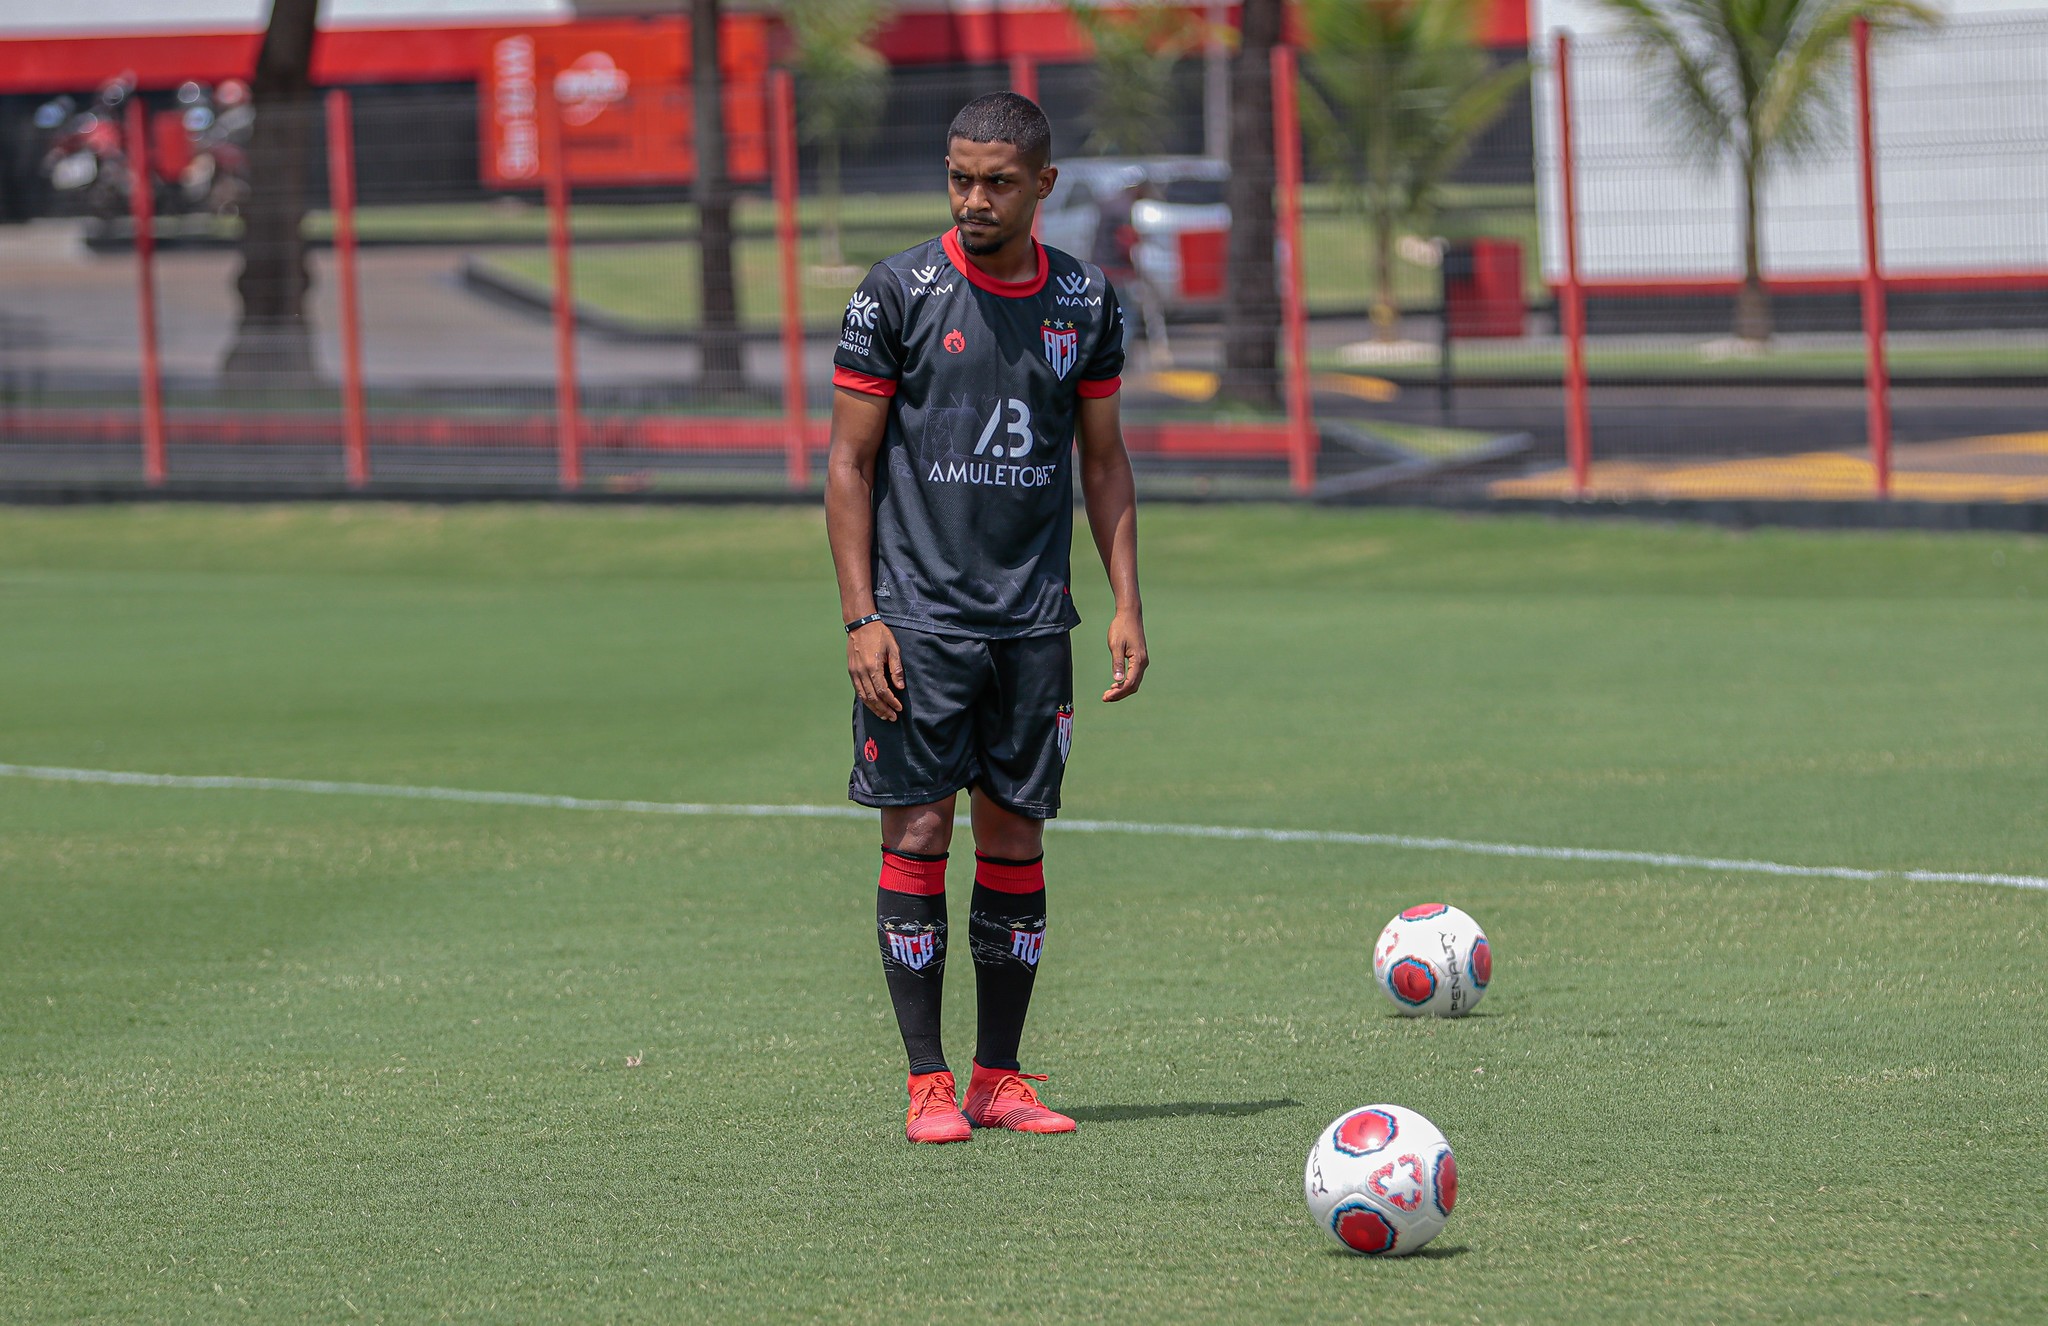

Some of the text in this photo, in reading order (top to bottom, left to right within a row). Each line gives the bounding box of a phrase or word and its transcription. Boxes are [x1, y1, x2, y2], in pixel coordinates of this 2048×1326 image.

[909, 283, 953, 298] WAM
[1055, 295, 1102, 307] WAM
[841, 326, 873, 348] ristal
[838, 339, 870, 357] MENTOS
[1438, 931, 1462, 1011] PENALTY
